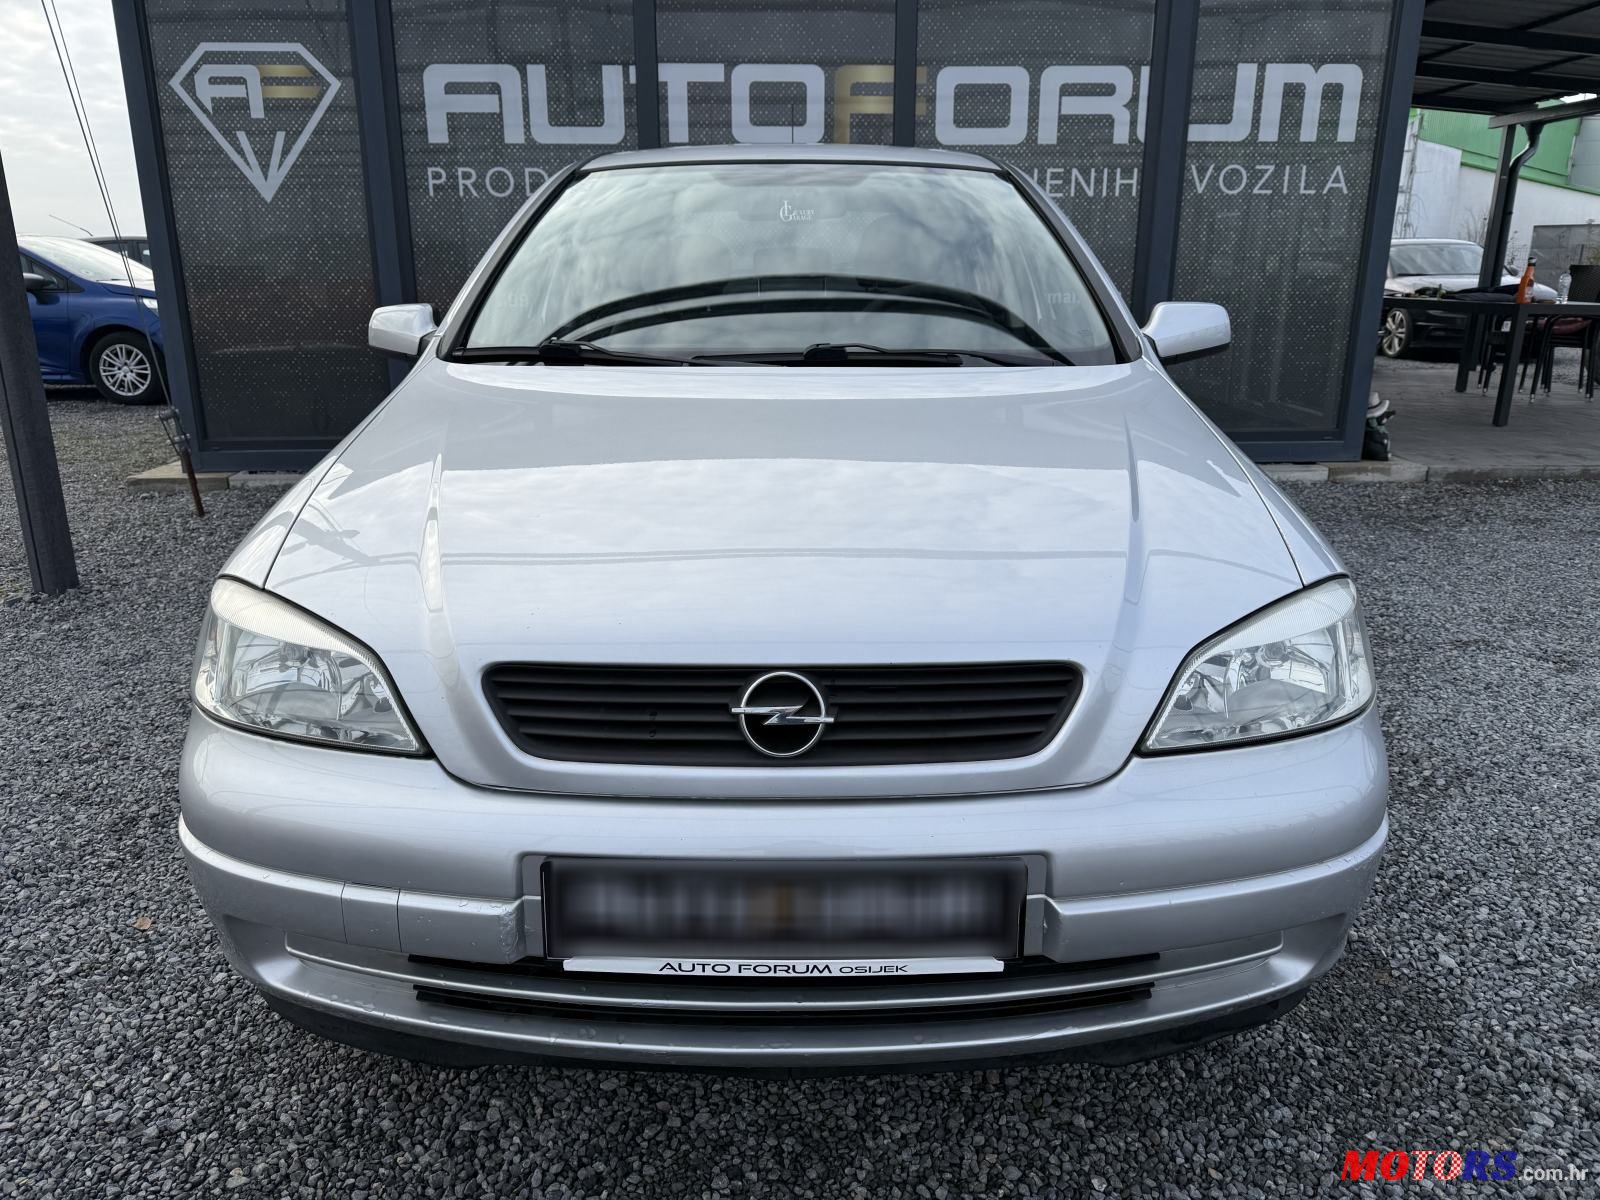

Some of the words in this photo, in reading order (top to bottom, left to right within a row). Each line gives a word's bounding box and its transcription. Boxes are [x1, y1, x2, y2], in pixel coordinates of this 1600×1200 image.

[422, 62, 1364, 145] AUTOFORUM
[427, 166, 549, 198] PROD
[1191, 164, 1349, 195] VOZILA
[659, 962, 731, 974] AUTO
[738, 963, 833, 975] FORUM
[839, 964, 909, 974] OSIJEK
